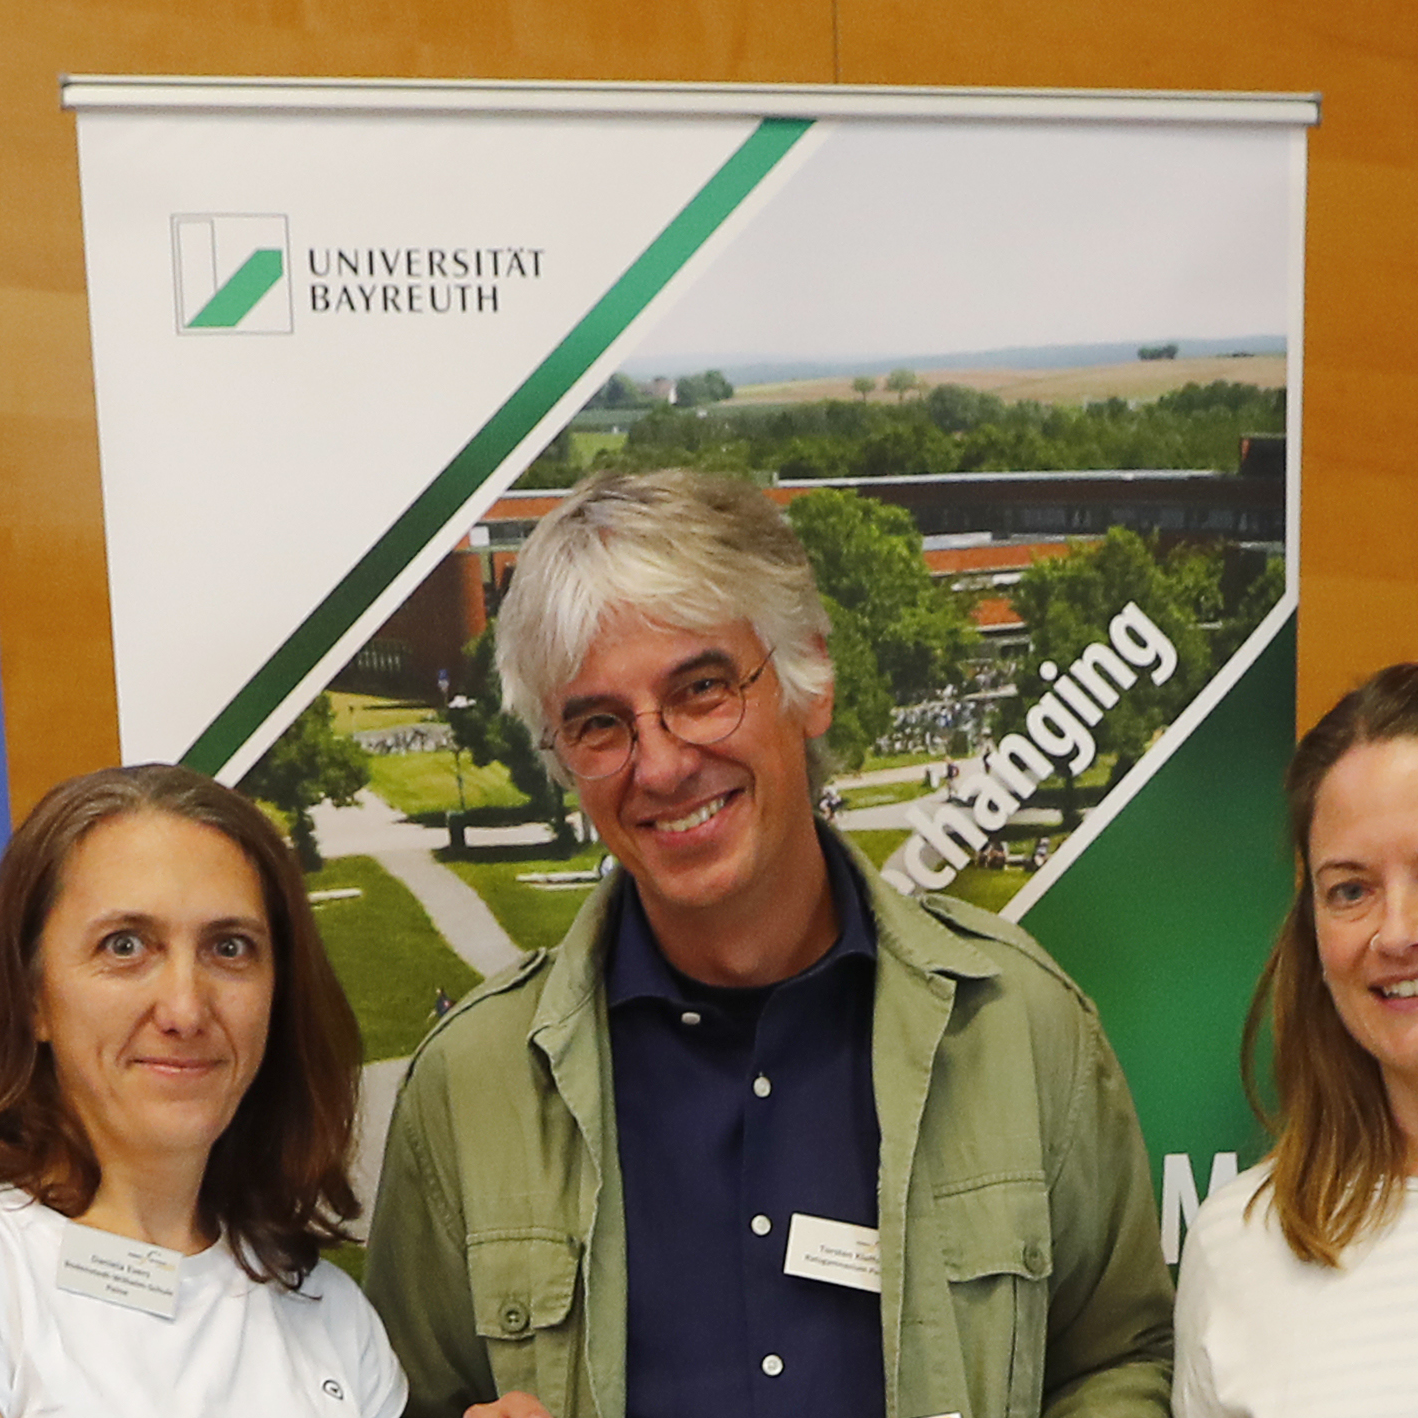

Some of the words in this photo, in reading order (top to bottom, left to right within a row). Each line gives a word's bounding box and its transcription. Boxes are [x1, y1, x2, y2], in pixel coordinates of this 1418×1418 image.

[308, 246, 544, 277] UNIVERSITÄT
[310, 284, 499, 312] BAYREUTH
[881, 600, 1179, 895] changing
